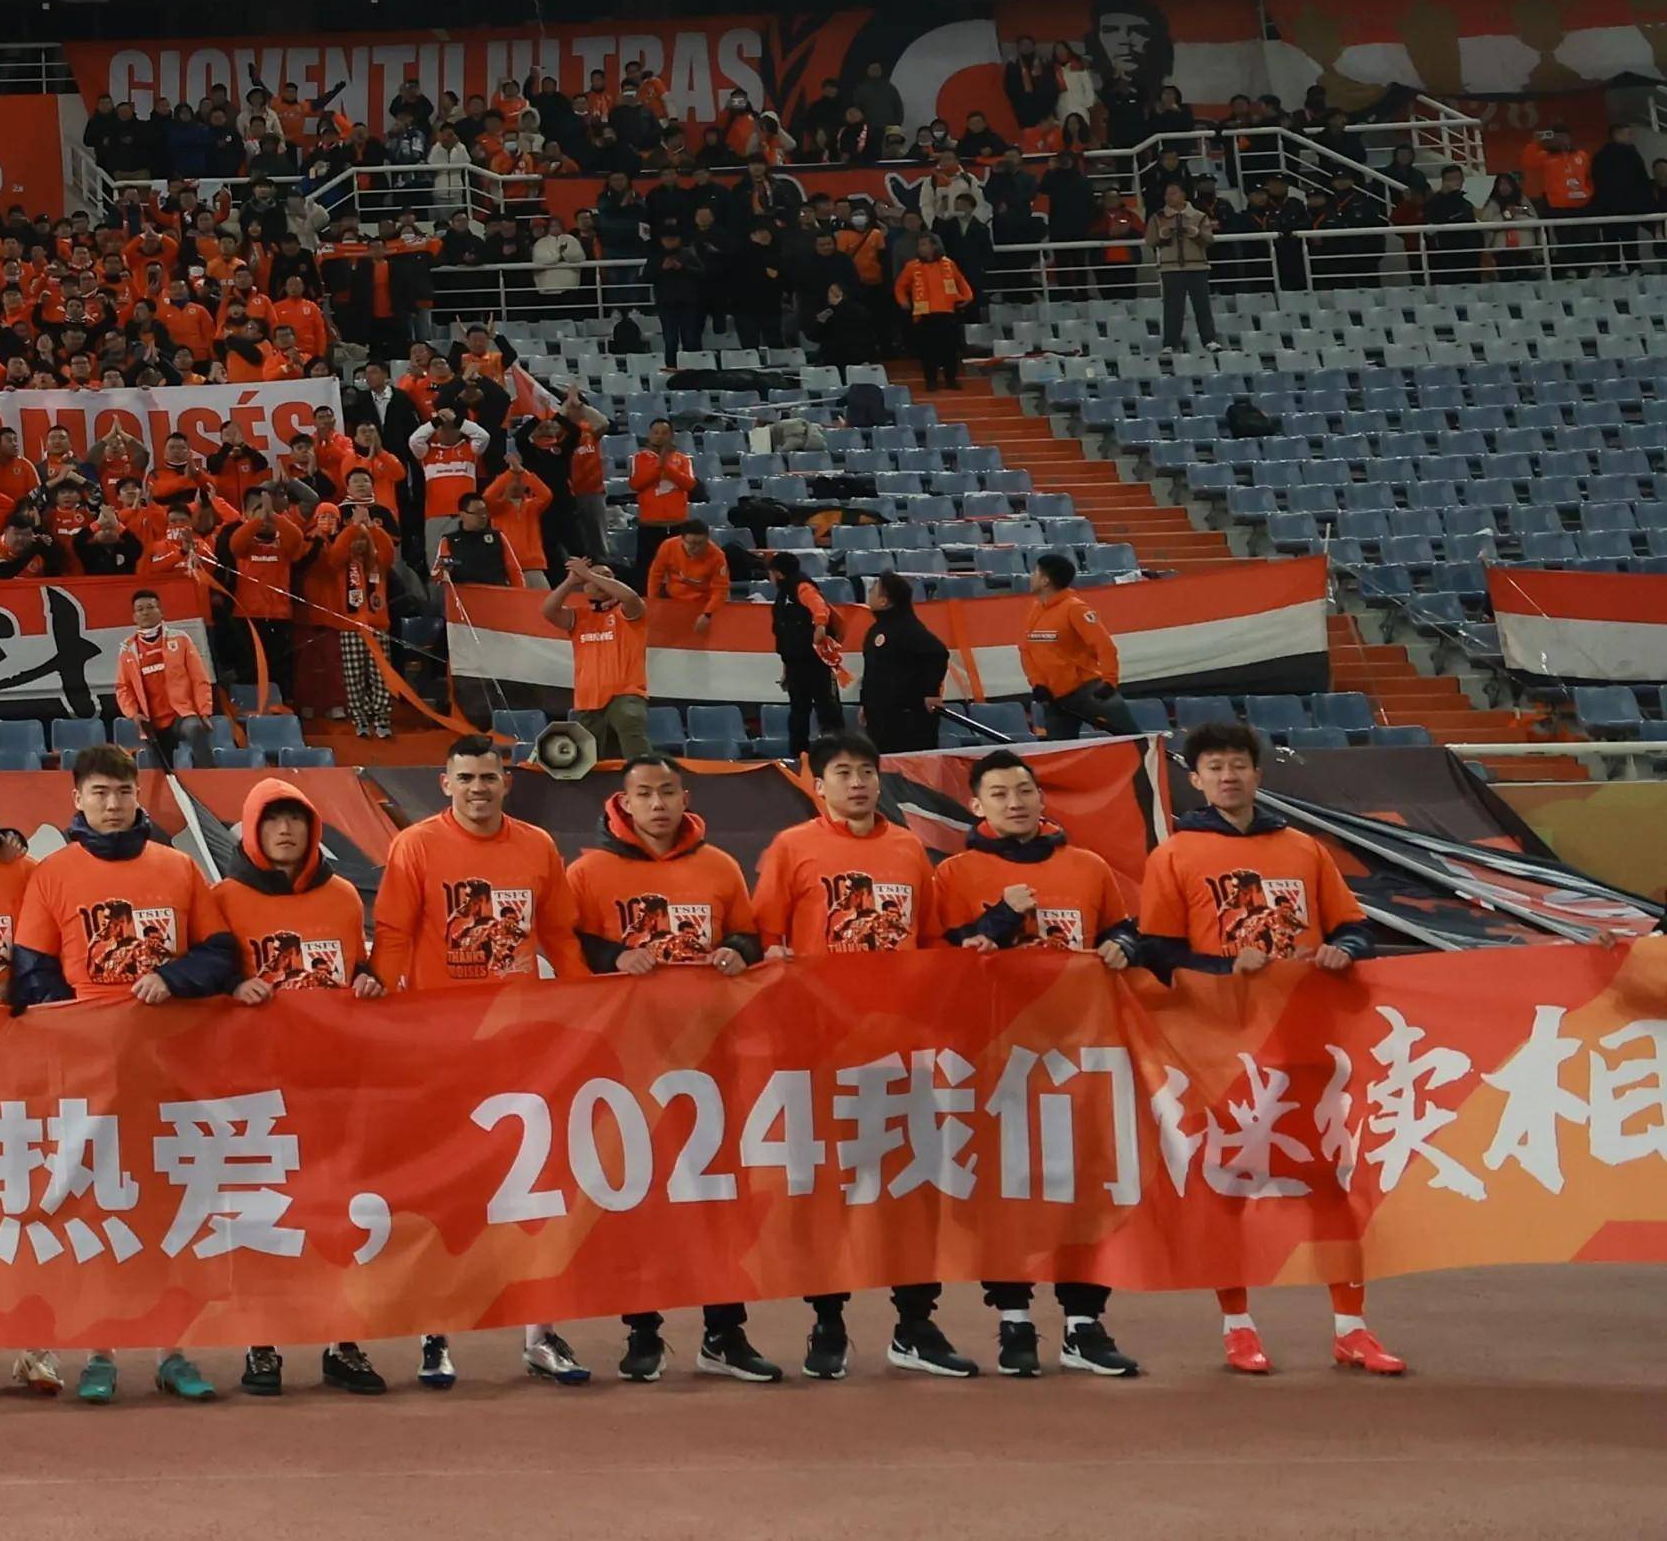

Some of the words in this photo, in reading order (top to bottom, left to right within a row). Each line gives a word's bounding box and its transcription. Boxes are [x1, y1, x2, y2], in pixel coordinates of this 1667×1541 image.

[874, 883, 912, 894] TSFC
[1266, 880, 1301, 891] TSFC
[492, 890, 532, 900] TSFC
[137, 909, 172, 919] TSFC
[670, 905, 710, 915] TSFC
[1040, 909, 1080, 920] TSFC
[303, 942, 340, 952] TSFC
